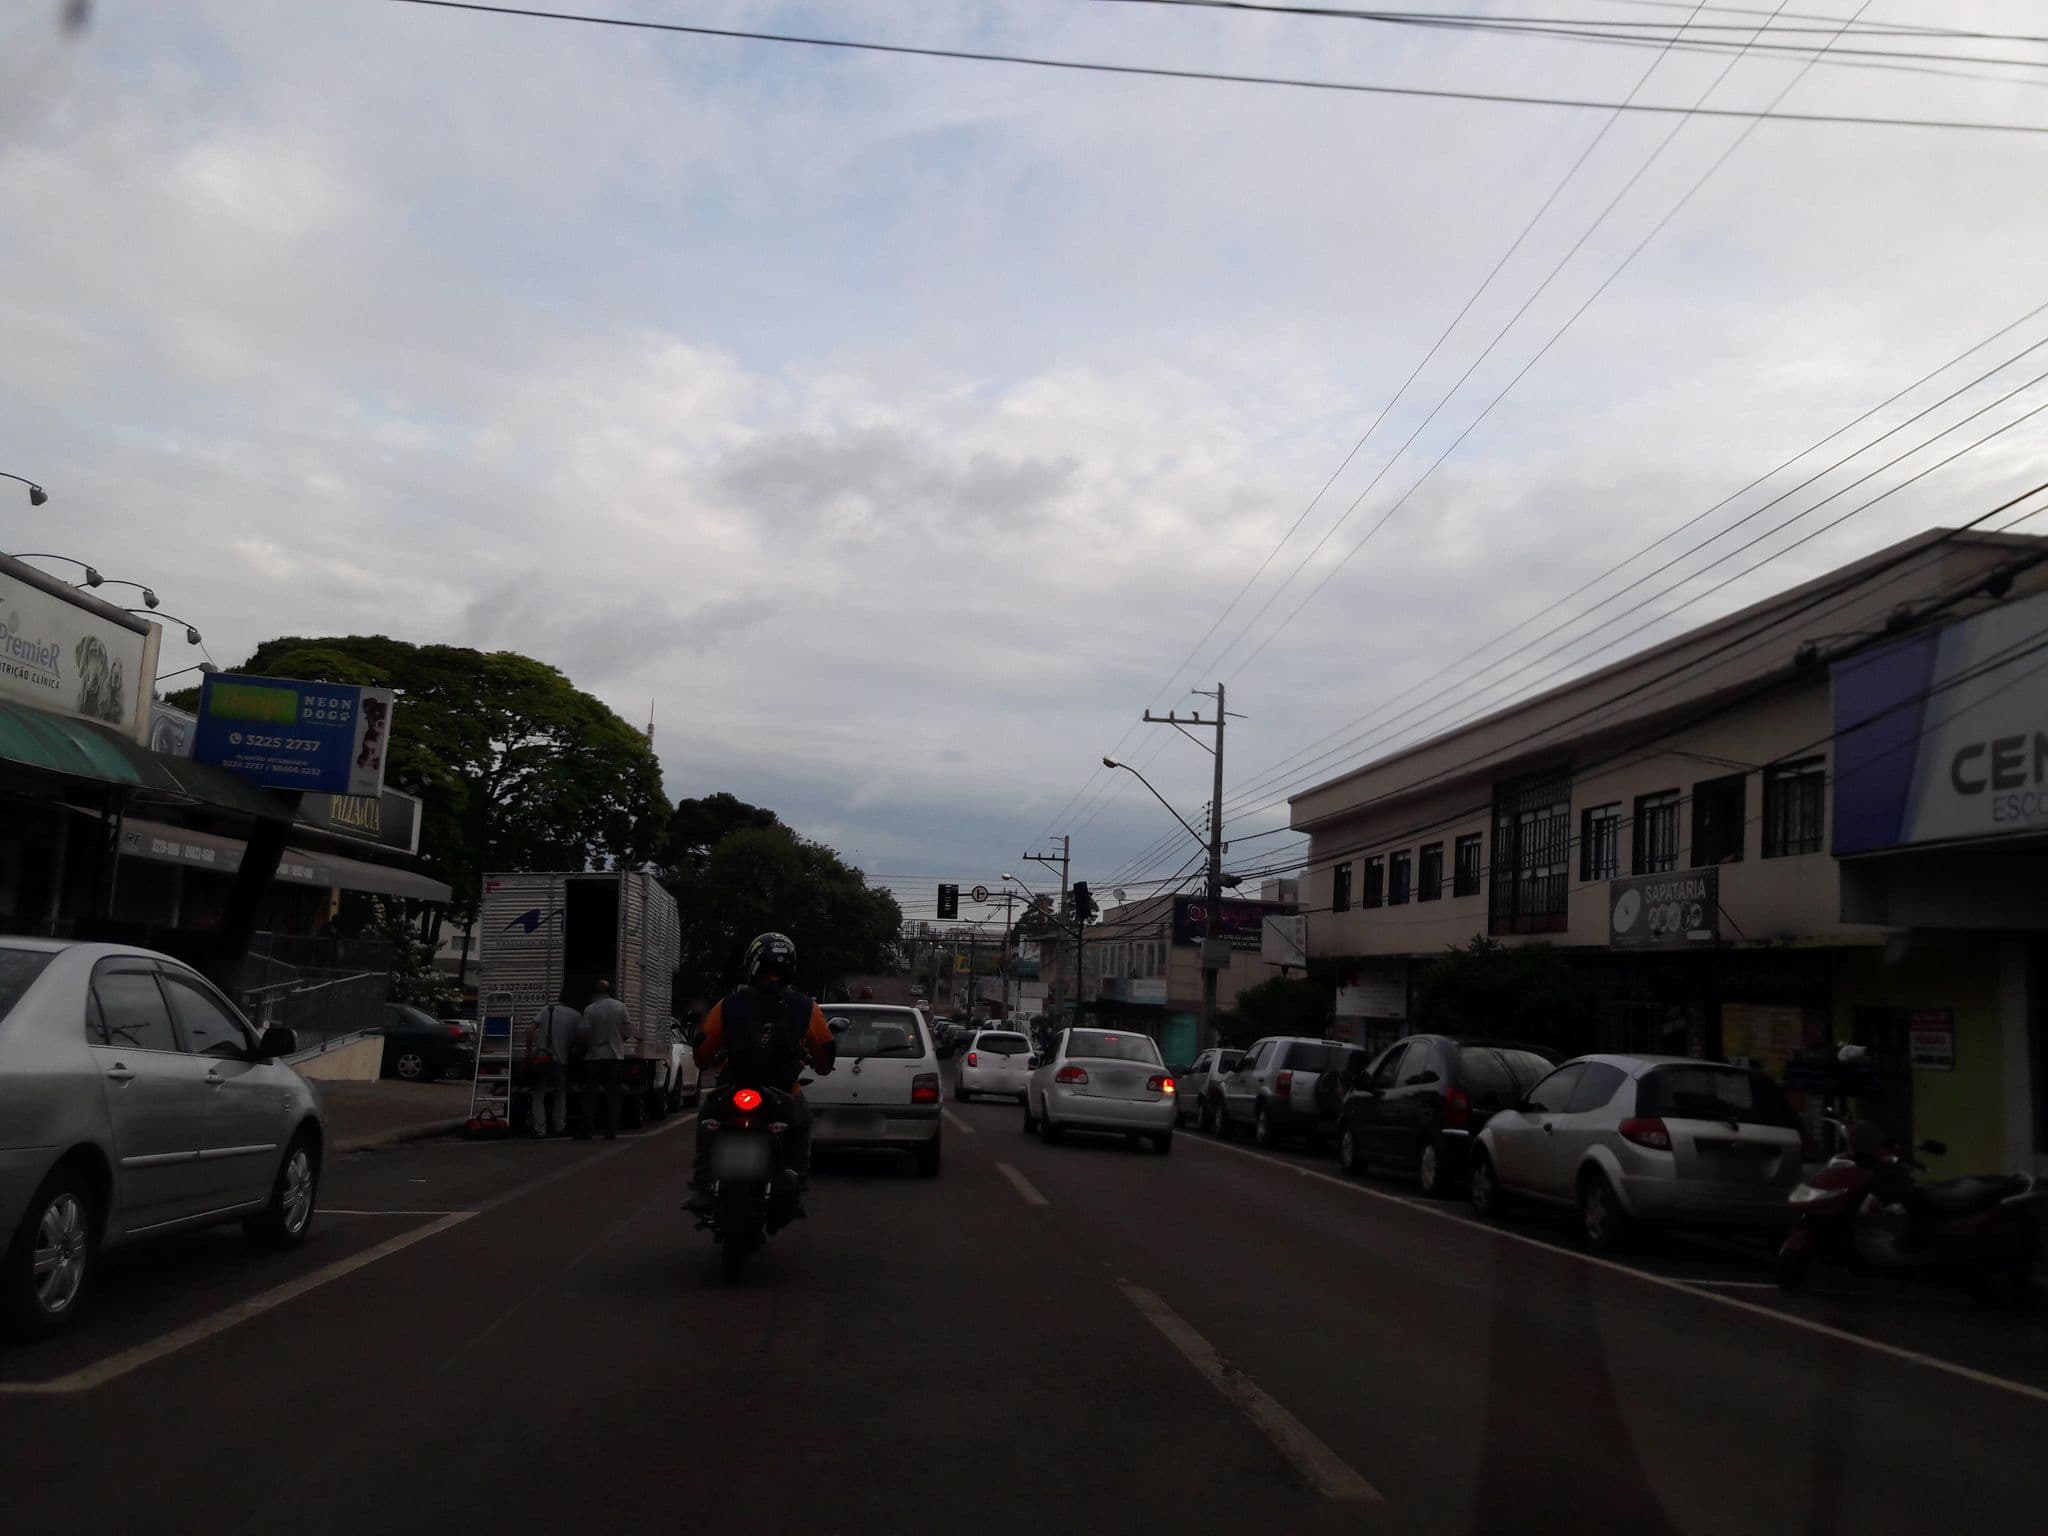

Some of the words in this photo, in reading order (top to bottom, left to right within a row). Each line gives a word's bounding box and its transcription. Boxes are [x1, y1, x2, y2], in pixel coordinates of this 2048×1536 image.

[0, 661, 29, 681] TRIÇÃO
[32, 671, 60, 690] CLÍNICA
[303, 695, 352, 711] NEON
[245, 734, 281, 749] 3225
[284, 737, 321, 752] 2737
[1645, 878, 1707, 905] SAPATARIA
